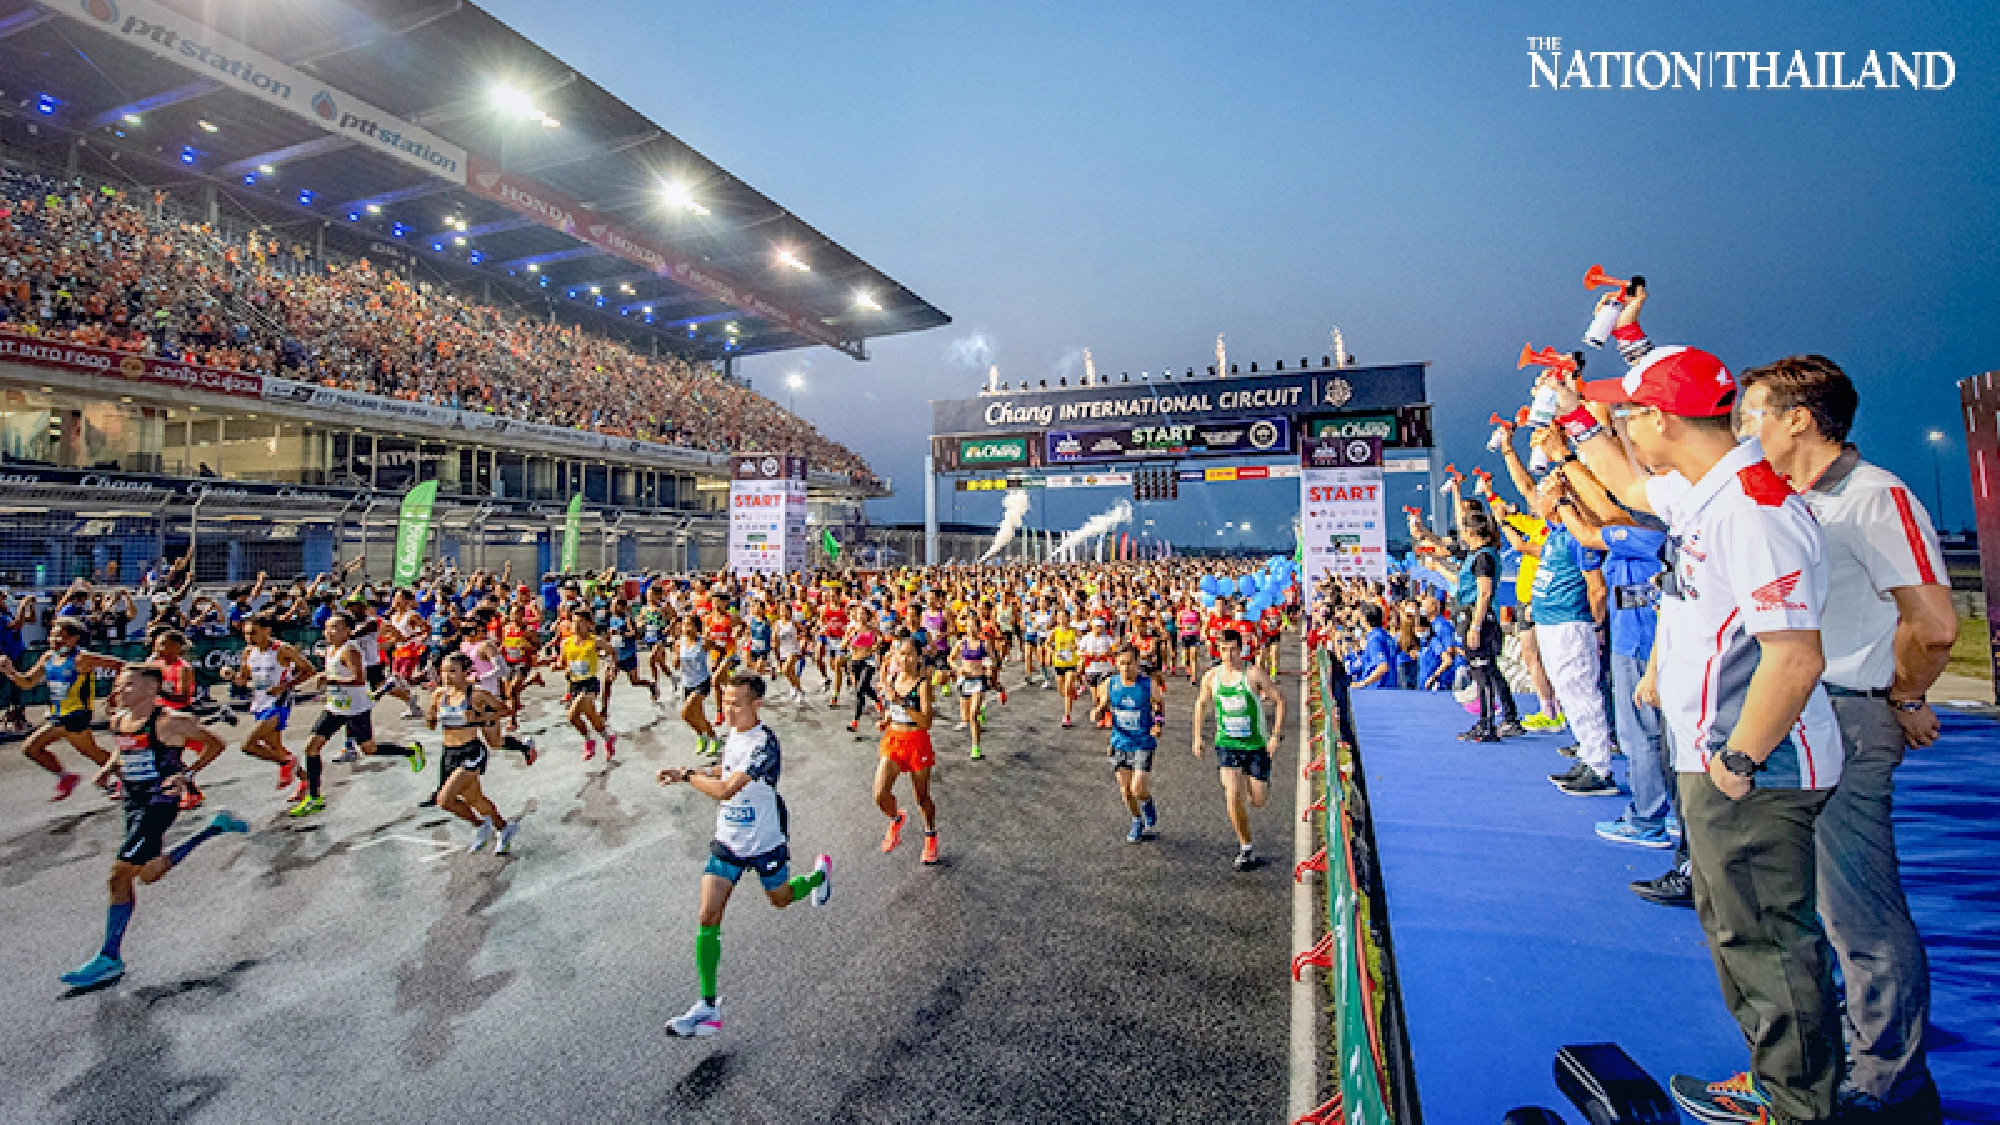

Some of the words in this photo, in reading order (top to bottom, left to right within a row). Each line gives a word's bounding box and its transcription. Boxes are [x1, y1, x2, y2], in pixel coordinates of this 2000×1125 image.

[501, 184, 576, 229] HONDA
[20, 343, 64, 361] INTO
[66, 350, 111, 370] FOOD
[985, 402, 1053, 425] Chang
[1059, 394, 1213, 421] INTERNATIONAL
[1219, 386, 1303, 409] CIRCUIT
[1131, 425, 1195, 444] START
[735, 494, 781, 507] START
[1309, 486, 1378, 502] START
[204, 649, 243, 669] Cha
